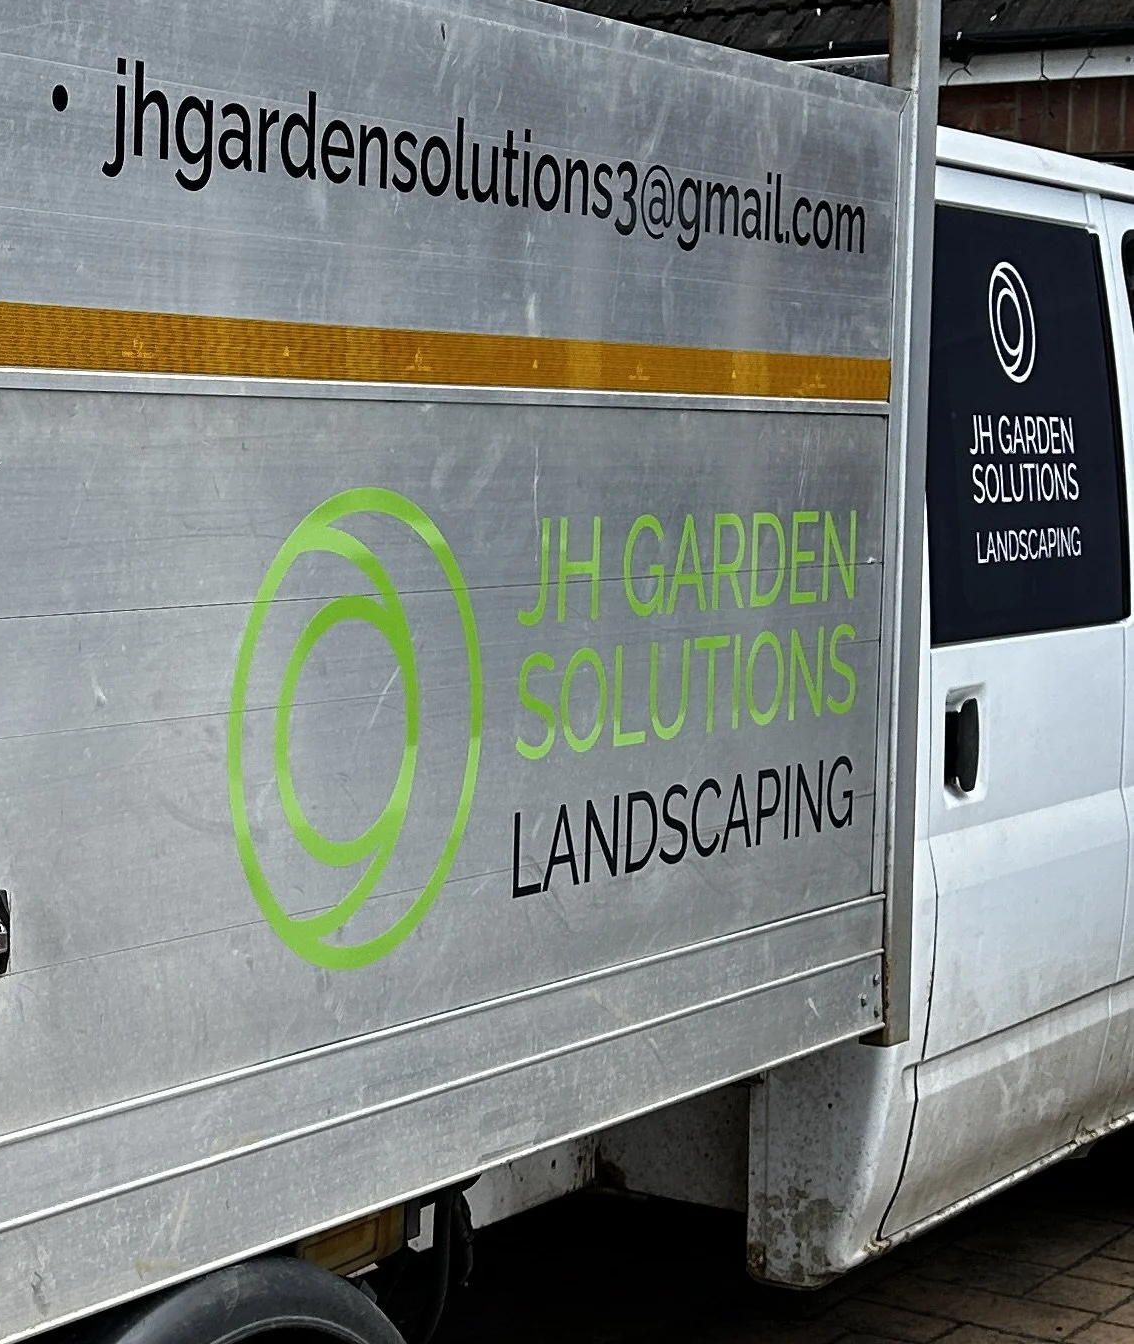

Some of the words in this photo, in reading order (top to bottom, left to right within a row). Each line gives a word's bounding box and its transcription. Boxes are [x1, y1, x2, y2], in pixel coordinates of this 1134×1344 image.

[101, 57, 867, 255] jhgardensolutions3@gmail.com
[969, 414, 994, 455] JH
[997, 415, 1075, 455] GARDEN
[972, 462, 1080, 504] SOLUTIONS
[517, 516, 602, 627] JH
[622, 510, 858, 618] GARDEN
[976, 526, 1082, 564] LANDSCAPING
[516, 624, 857, 761] SOLUTIONS
[512, 755, 854, 899] LANDSCAPING
